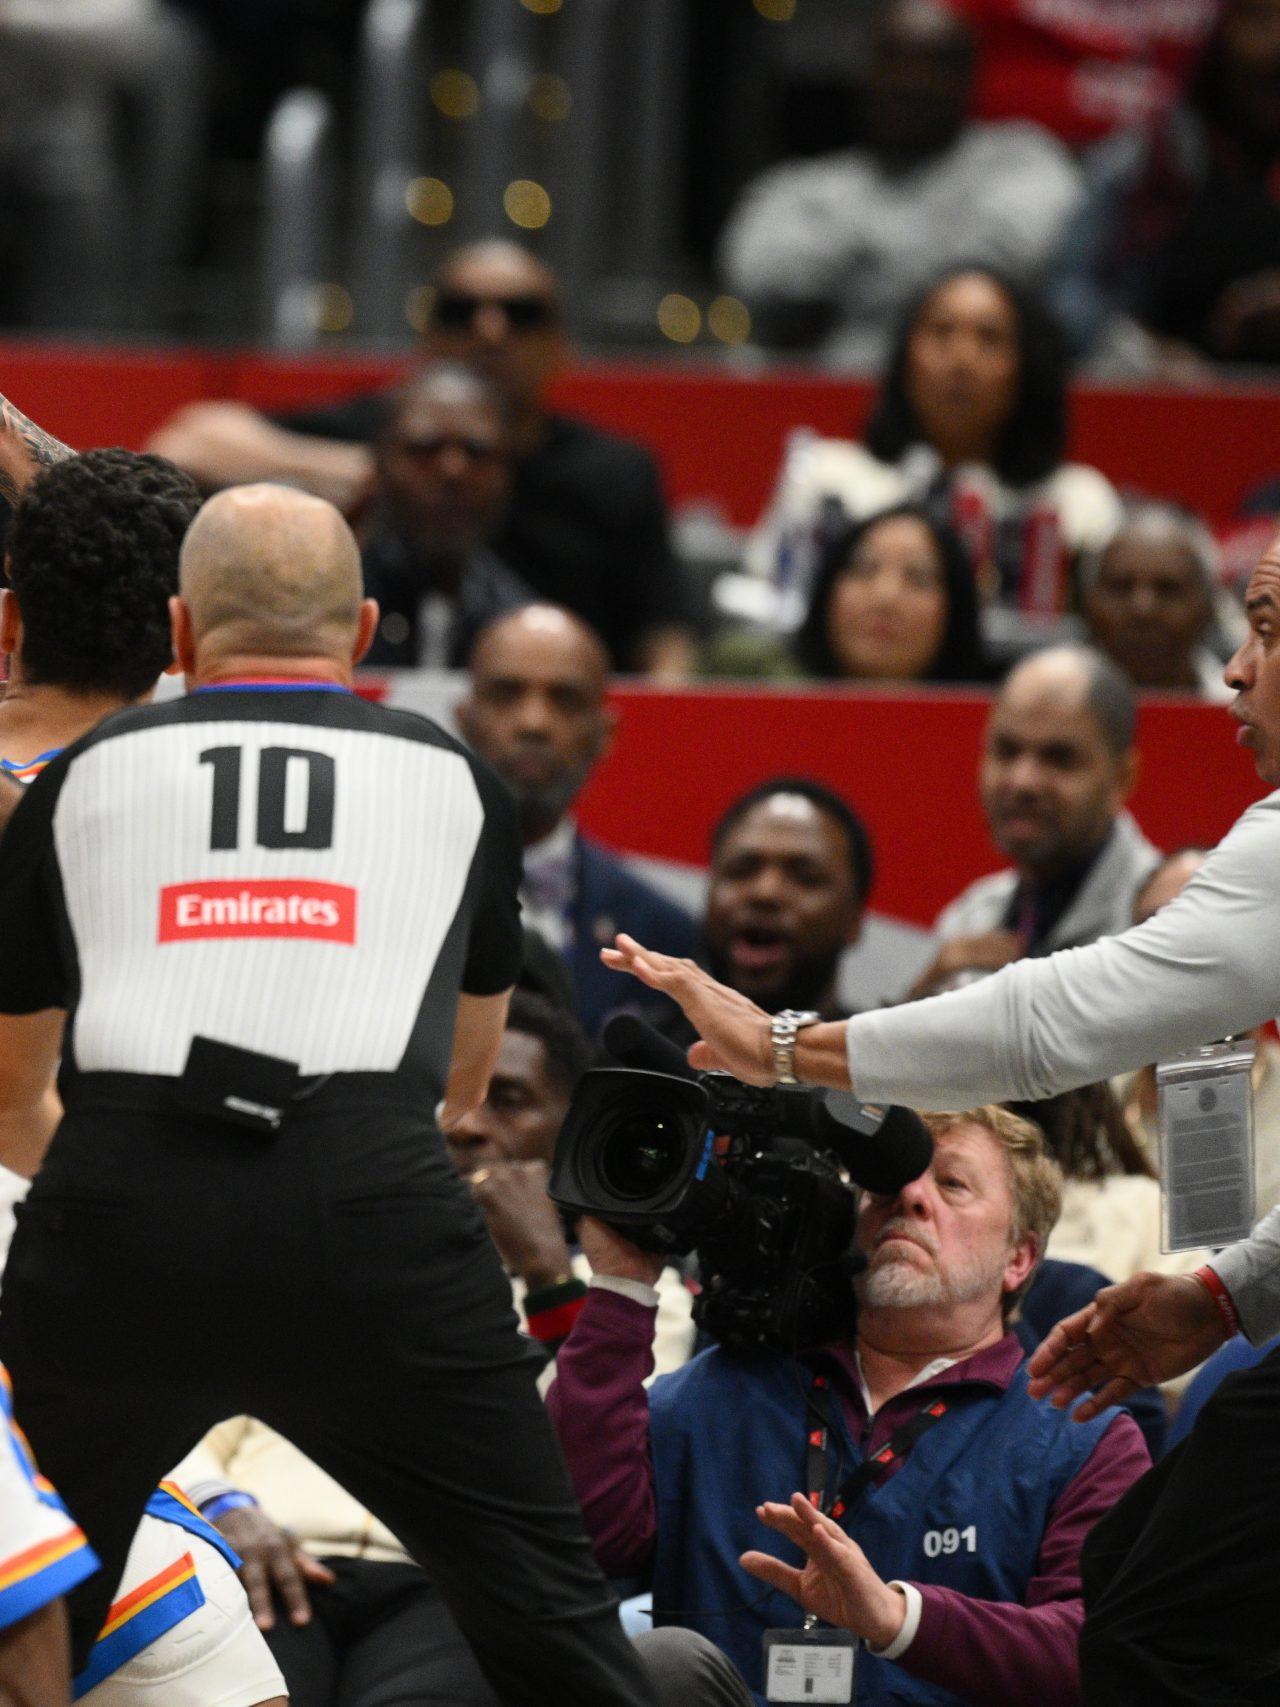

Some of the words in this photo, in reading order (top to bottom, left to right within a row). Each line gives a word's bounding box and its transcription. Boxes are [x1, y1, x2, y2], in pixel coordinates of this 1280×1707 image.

[199, 745, 335, 851] 10
[175, 891, 340, 928] Emirates
[923, 1525, 977, 1558] 091
